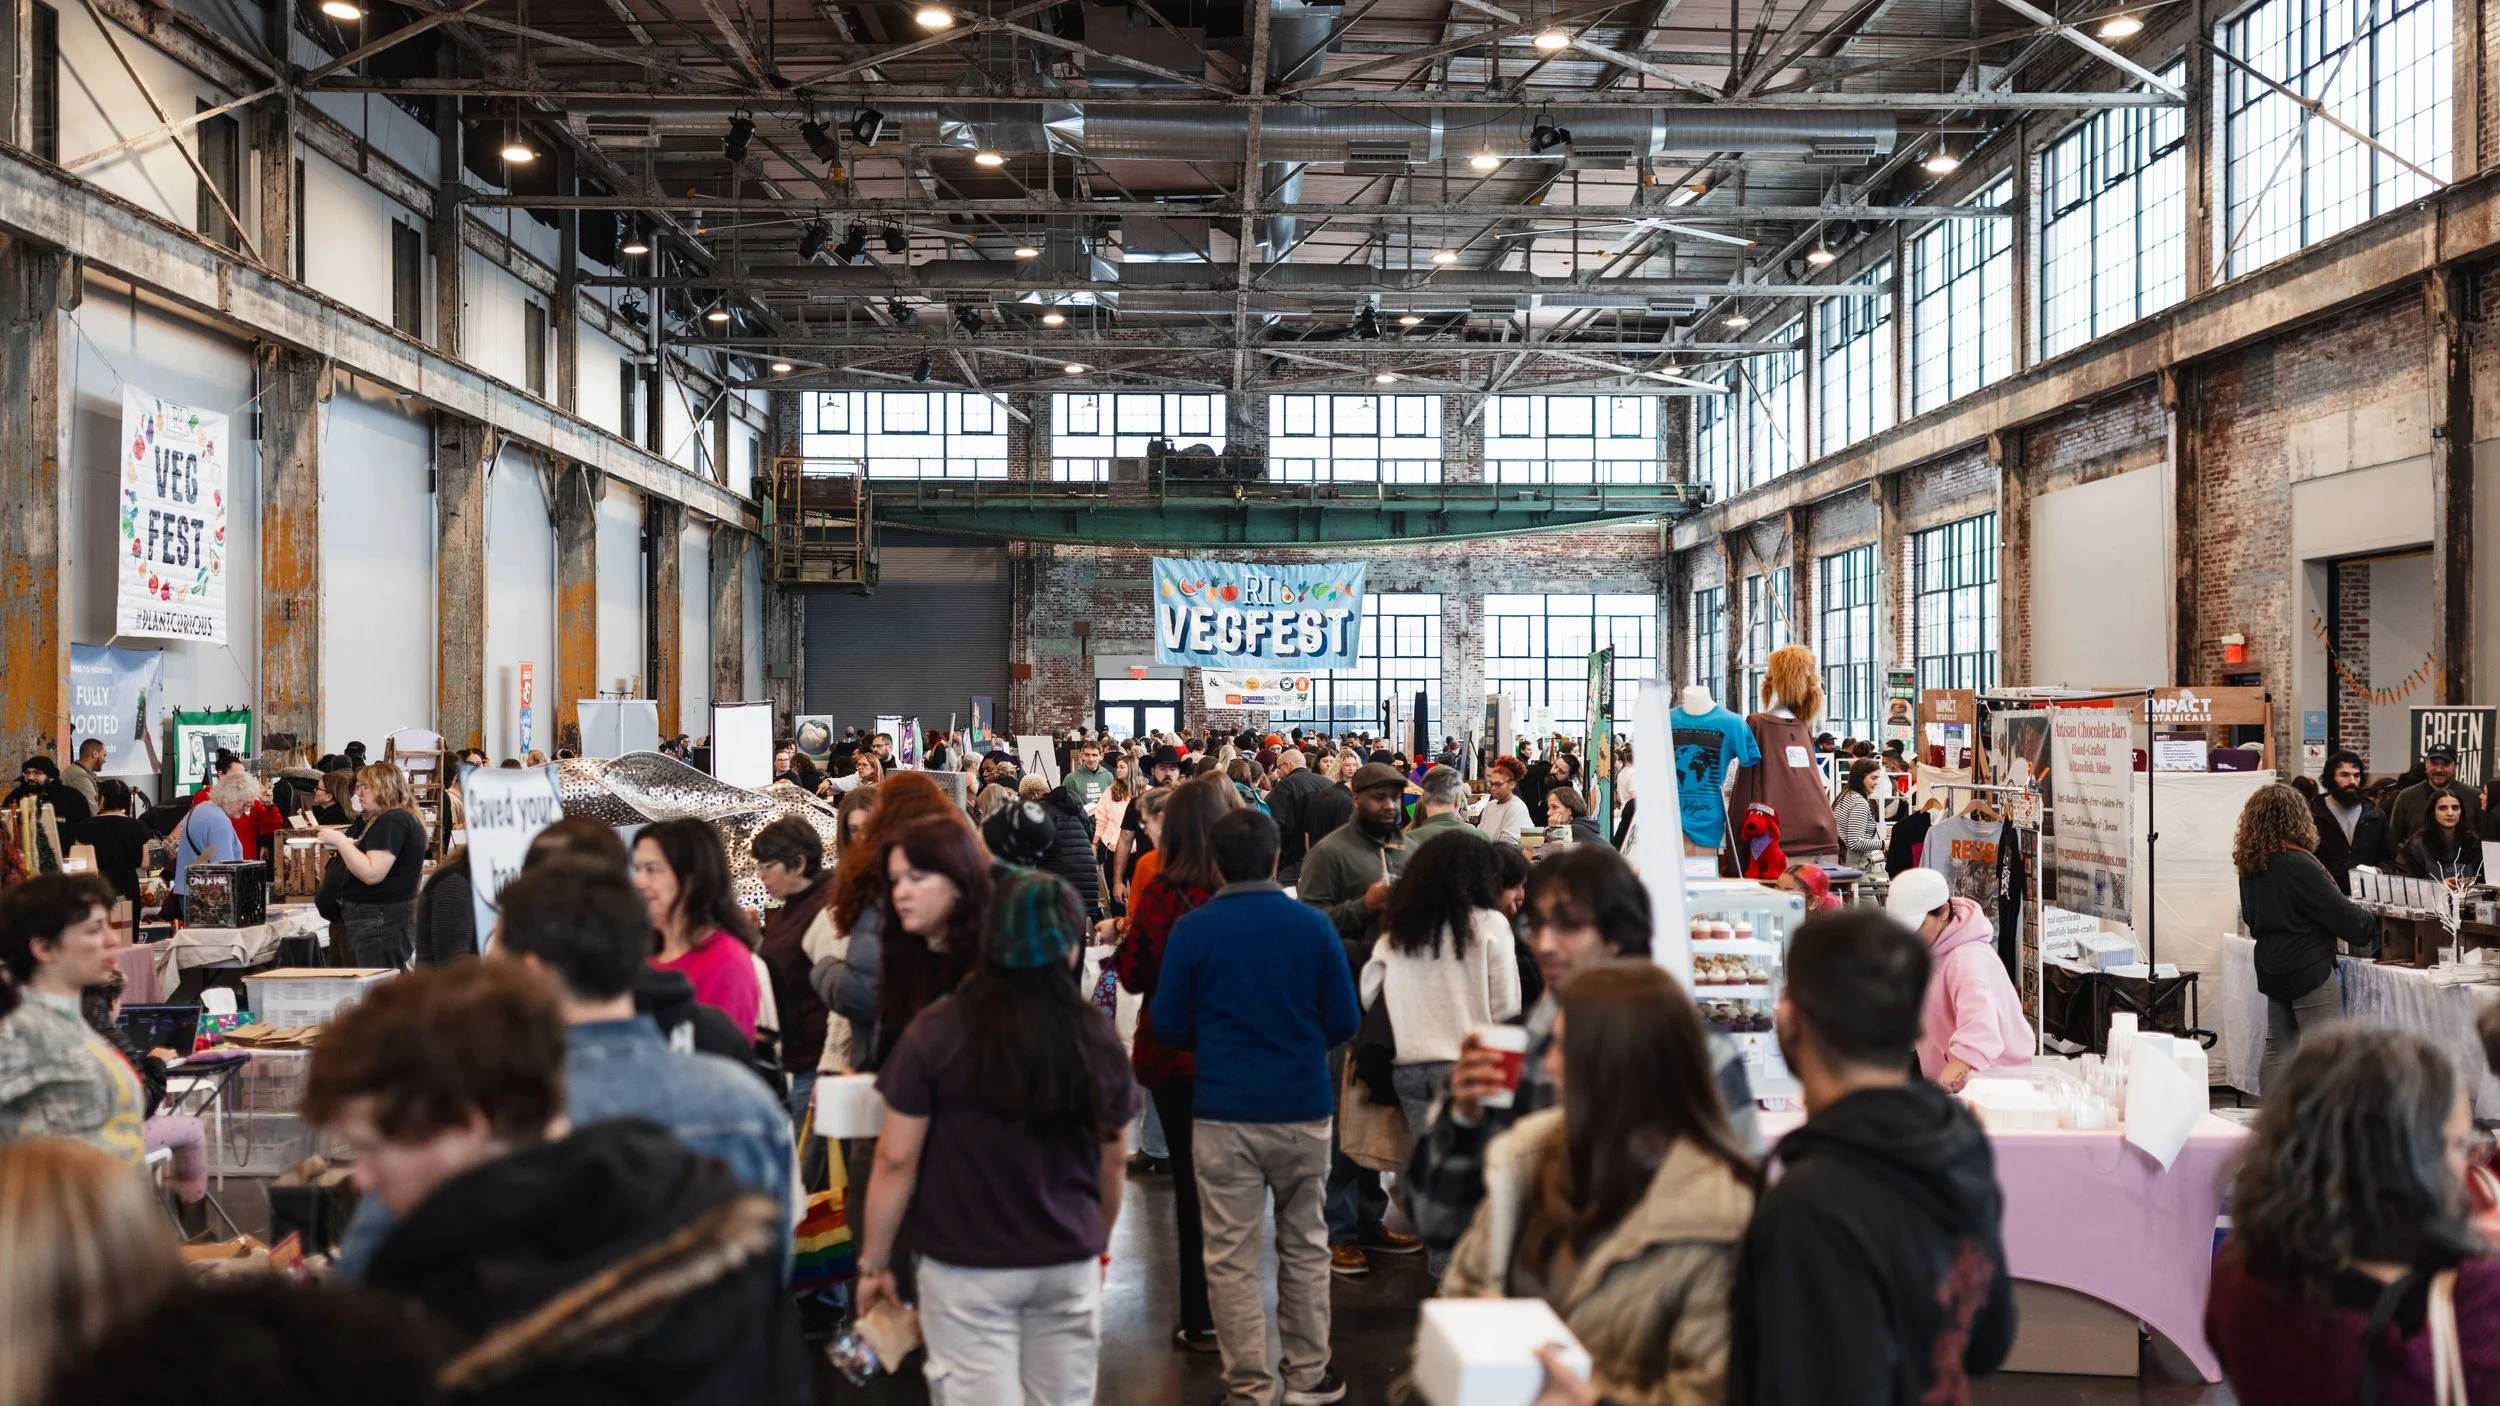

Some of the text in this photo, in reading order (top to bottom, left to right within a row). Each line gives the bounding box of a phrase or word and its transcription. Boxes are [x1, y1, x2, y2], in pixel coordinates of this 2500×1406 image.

[155, 445, 198, 504] VEG
[148, 509, 204, 569] FEST
[1243, 575, 1273, 606] RI
[136, 608, 212, 636] #PLANTCURIOUS
[1160, 604, 1351, 656] VEGFEST
[77, 685, 109, 706] FULLY
[2144, 698, 2212, 713] IMPACT
[2078, 721, 2110, 739] Chocolate
[2112, 722, 2127, 739] Bars
[2420, 711, 2484, 758] GREEN
[469, 787, 514, 830] Saved
[1683, 800, 1713, 816] Vegan
